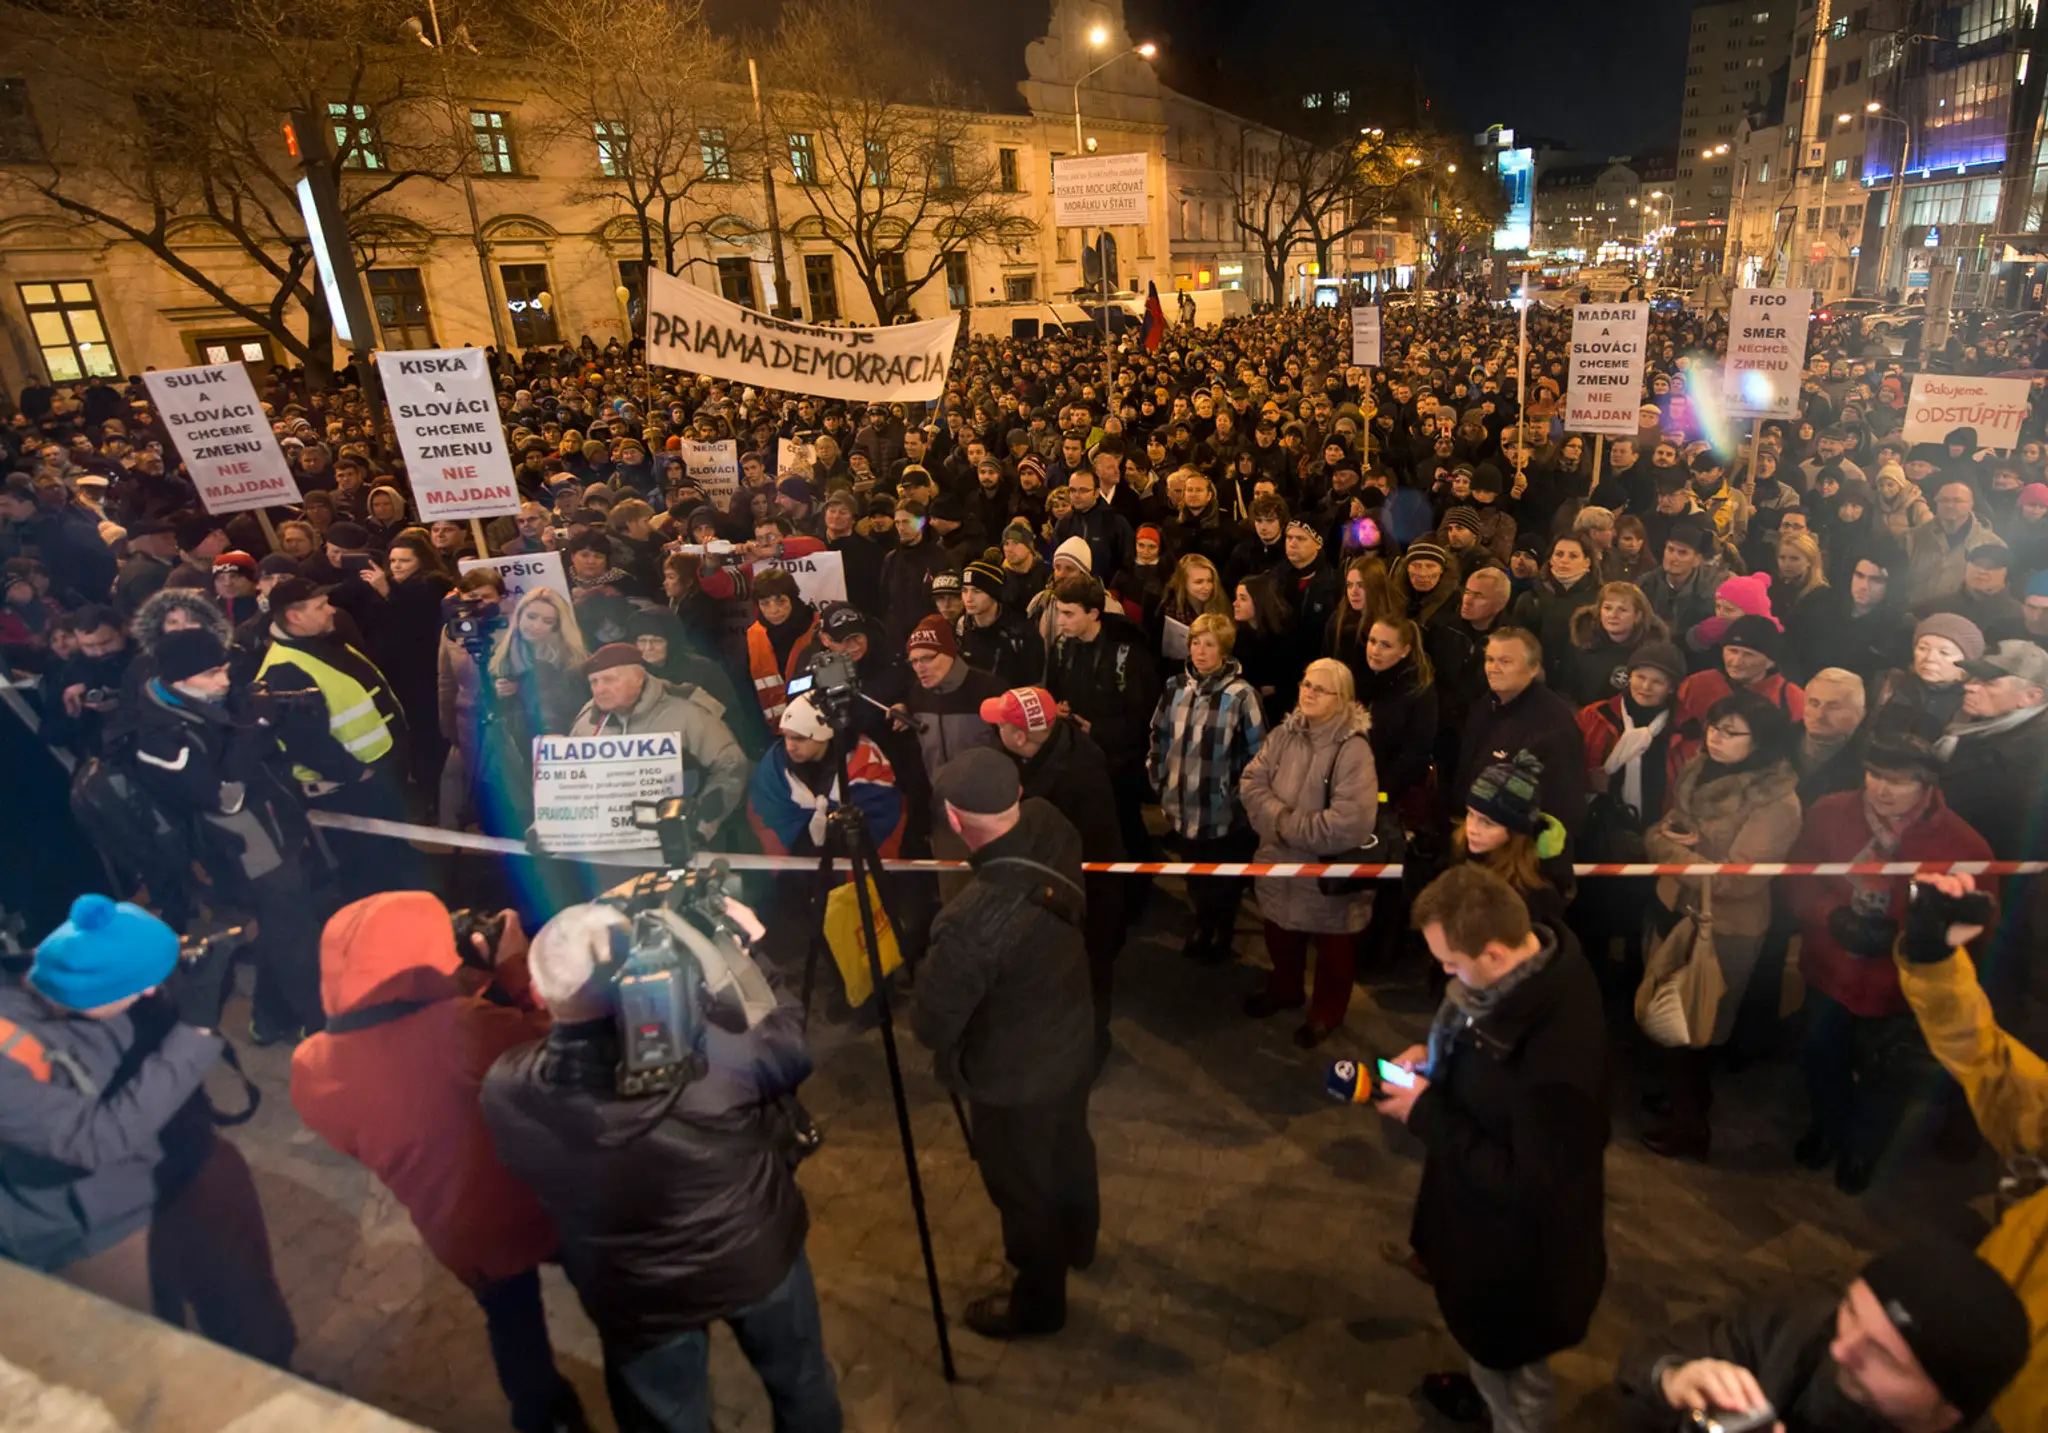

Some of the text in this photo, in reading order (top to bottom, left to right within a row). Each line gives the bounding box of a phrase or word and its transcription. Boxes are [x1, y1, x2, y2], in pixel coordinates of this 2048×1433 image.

[1086, 184, 1104, 194] MOC
[1106, 179, 1144, 193] URČOVAŤ
[1064, 196, 1136, 210] MORÁLKU V ŠTÁTE!
[1750, 295, 1786, 306] FICO
[1578, 308, 1636, 321] MAĎARI
[1762, 312, 1770, 321] A
[1601, 327, 1610, 336] A
[1743, 328, 1786, 338] SMER
[1573, 340, 1636, 354] SLOVÁCI
[1737, 344, 1788, 354] NECHCE
[400, 358, 468, 375] KISKA
[1579, 360, 1630, 368] CHCEME
[1734, 358, 1788, 371] ZMENU
[165, 370, 226, 389] SULÍK
[1577, 374, 1630, 386] ZMENU
[434, 382, 446, 392] A
[199, 392, 211, 402] A
[1587, 392, 1613, 403] NIE
[169, 404, 254, 426] SLOVÁCI
[400, 398, 490, 419] SLOVÁCI
[1571, 410, 1632, 421] MAJDAN
[188, 424, 254, 441] CHCEME
[416, 422, 486, 437] CHCEME
[193, 440, 262, 460] ZMENU
[420, 442, 492, 460] ZMENU
[693, 444, 728, 452] NEMCI
[217, 462, 252, 476] NIE
[442, 466, 478, 480] NIE
[205, 477, 285, 498] MAJDAN
[704, 488, 733, 496] MENU
[426, 486, 511, 504] MAJDAN
[494, 561, 545, 577] PŠIC
[537, 738, 678, 761] HLADOVKA
[554, 770, 566, 780] MI
[570, 768, 588, 780] DÁ
[608, 804, 633, 812] ALEB
[611, 816, 636, 828] SM
